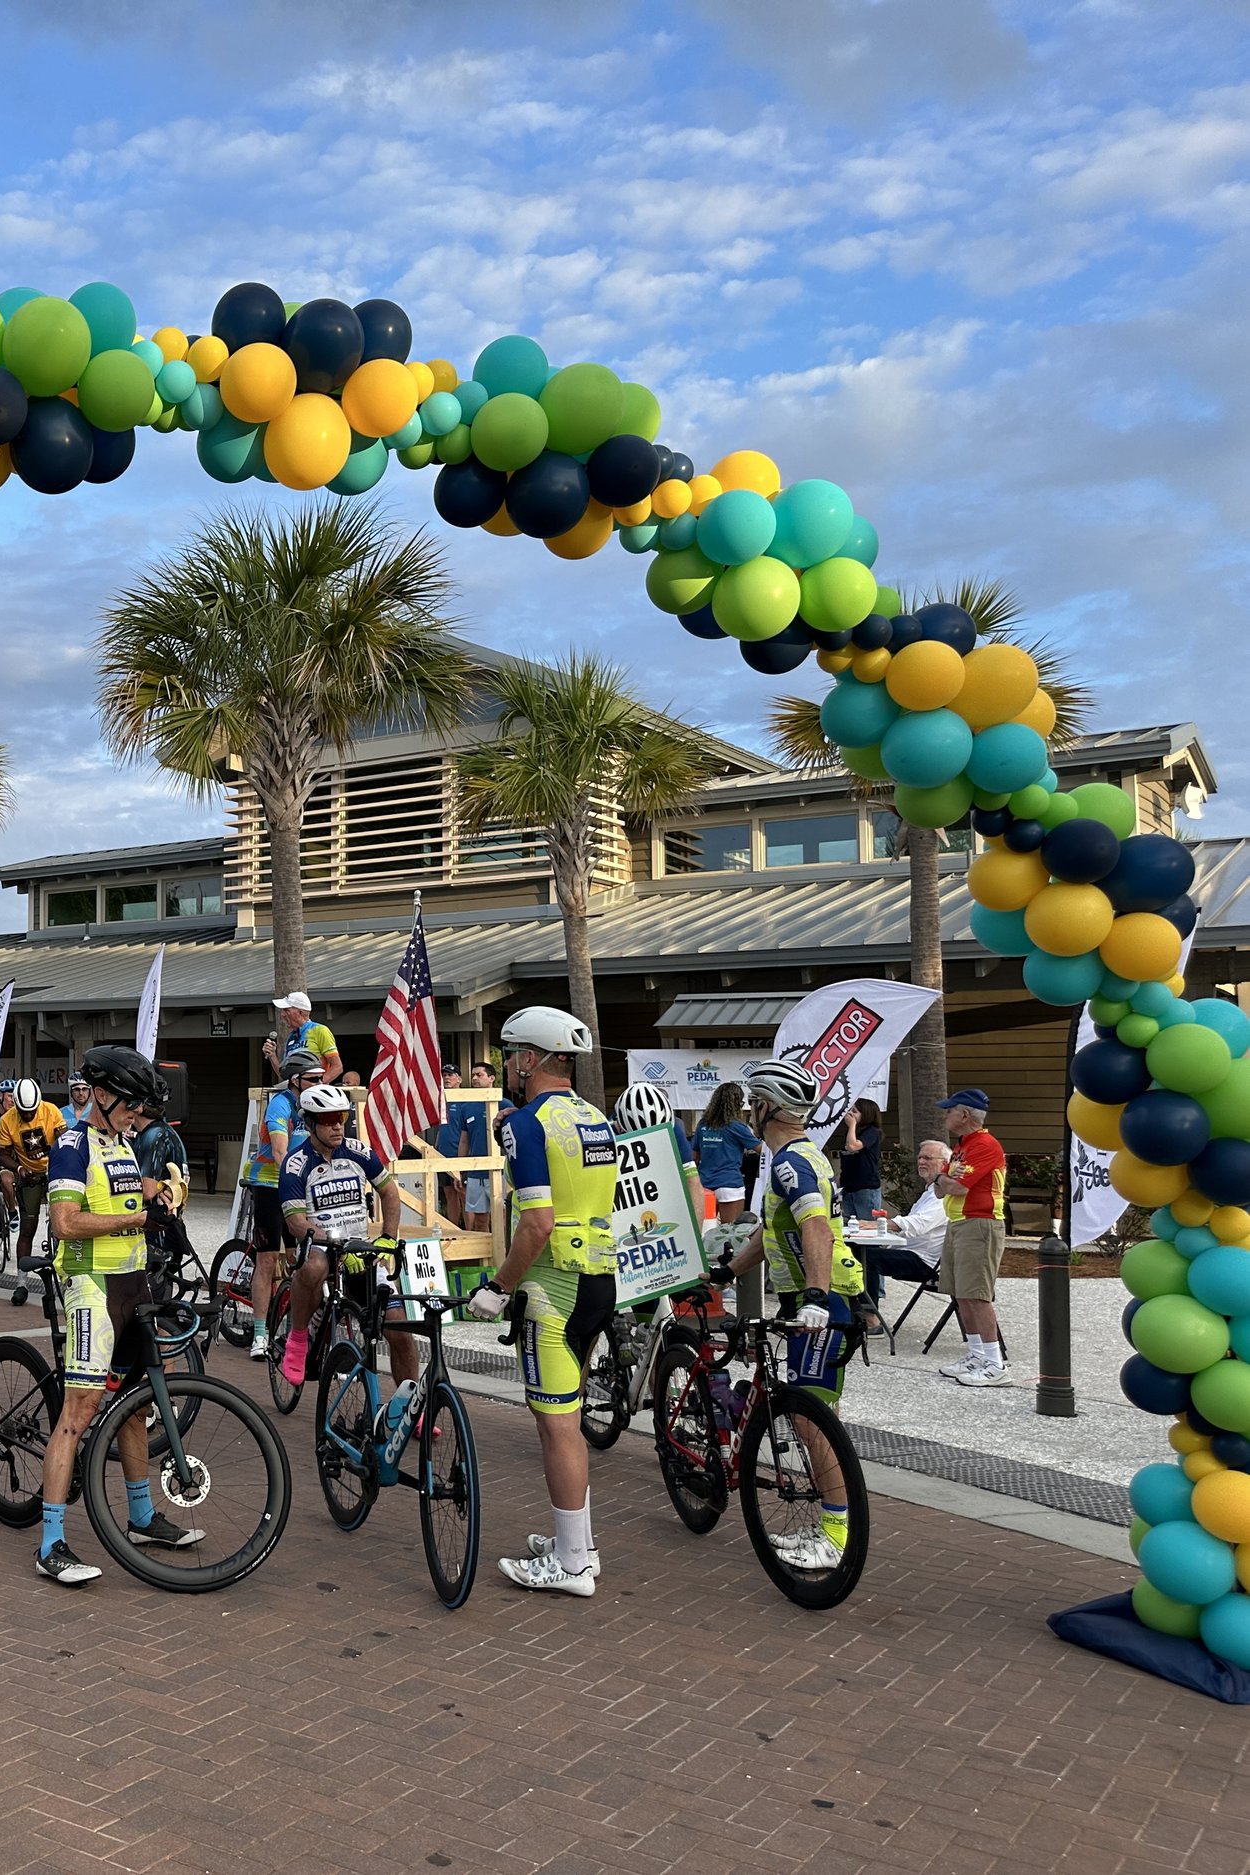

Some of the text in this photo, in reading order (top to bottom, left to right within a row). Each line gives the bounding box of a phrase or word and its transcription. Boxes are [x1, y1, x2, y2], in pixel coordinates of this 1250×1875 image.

[812, 1009, 871, 1081] OCTOR
[687, 1072, 720, 1081] PEDAL
[580, 1127, 610, 1142] Robson
[585, 1148, 615, 1163] Forensic
[617, 1140, 650, 1175] 2B
[107, 1163, 137, 1176] Robson
[114, 1180, 143, 1193] Forensic
[314, 1180, 359, 1197] Robson
[612, 1176, 659, 1212] Mile
[316, 1191, 360, 1206] Forensic
[110, 1228, 144, 1237] SUBA
[417, 1243, 429, 1260] 40
[617, 1236, 684, 1273] PEDAL
[415, 1263, 436, 1279] Mile
[620, 1268, 644, 1285] Hilton
[644, 1260, 665, 1279] Head
[665, 1252, 688, 1272] Island
[81, 1309, 90, 1361] Robson Forensic
[525, 1321, 537, 1385] Robson Forensic
[808, 1328, 828, 1375] Robson Forens
